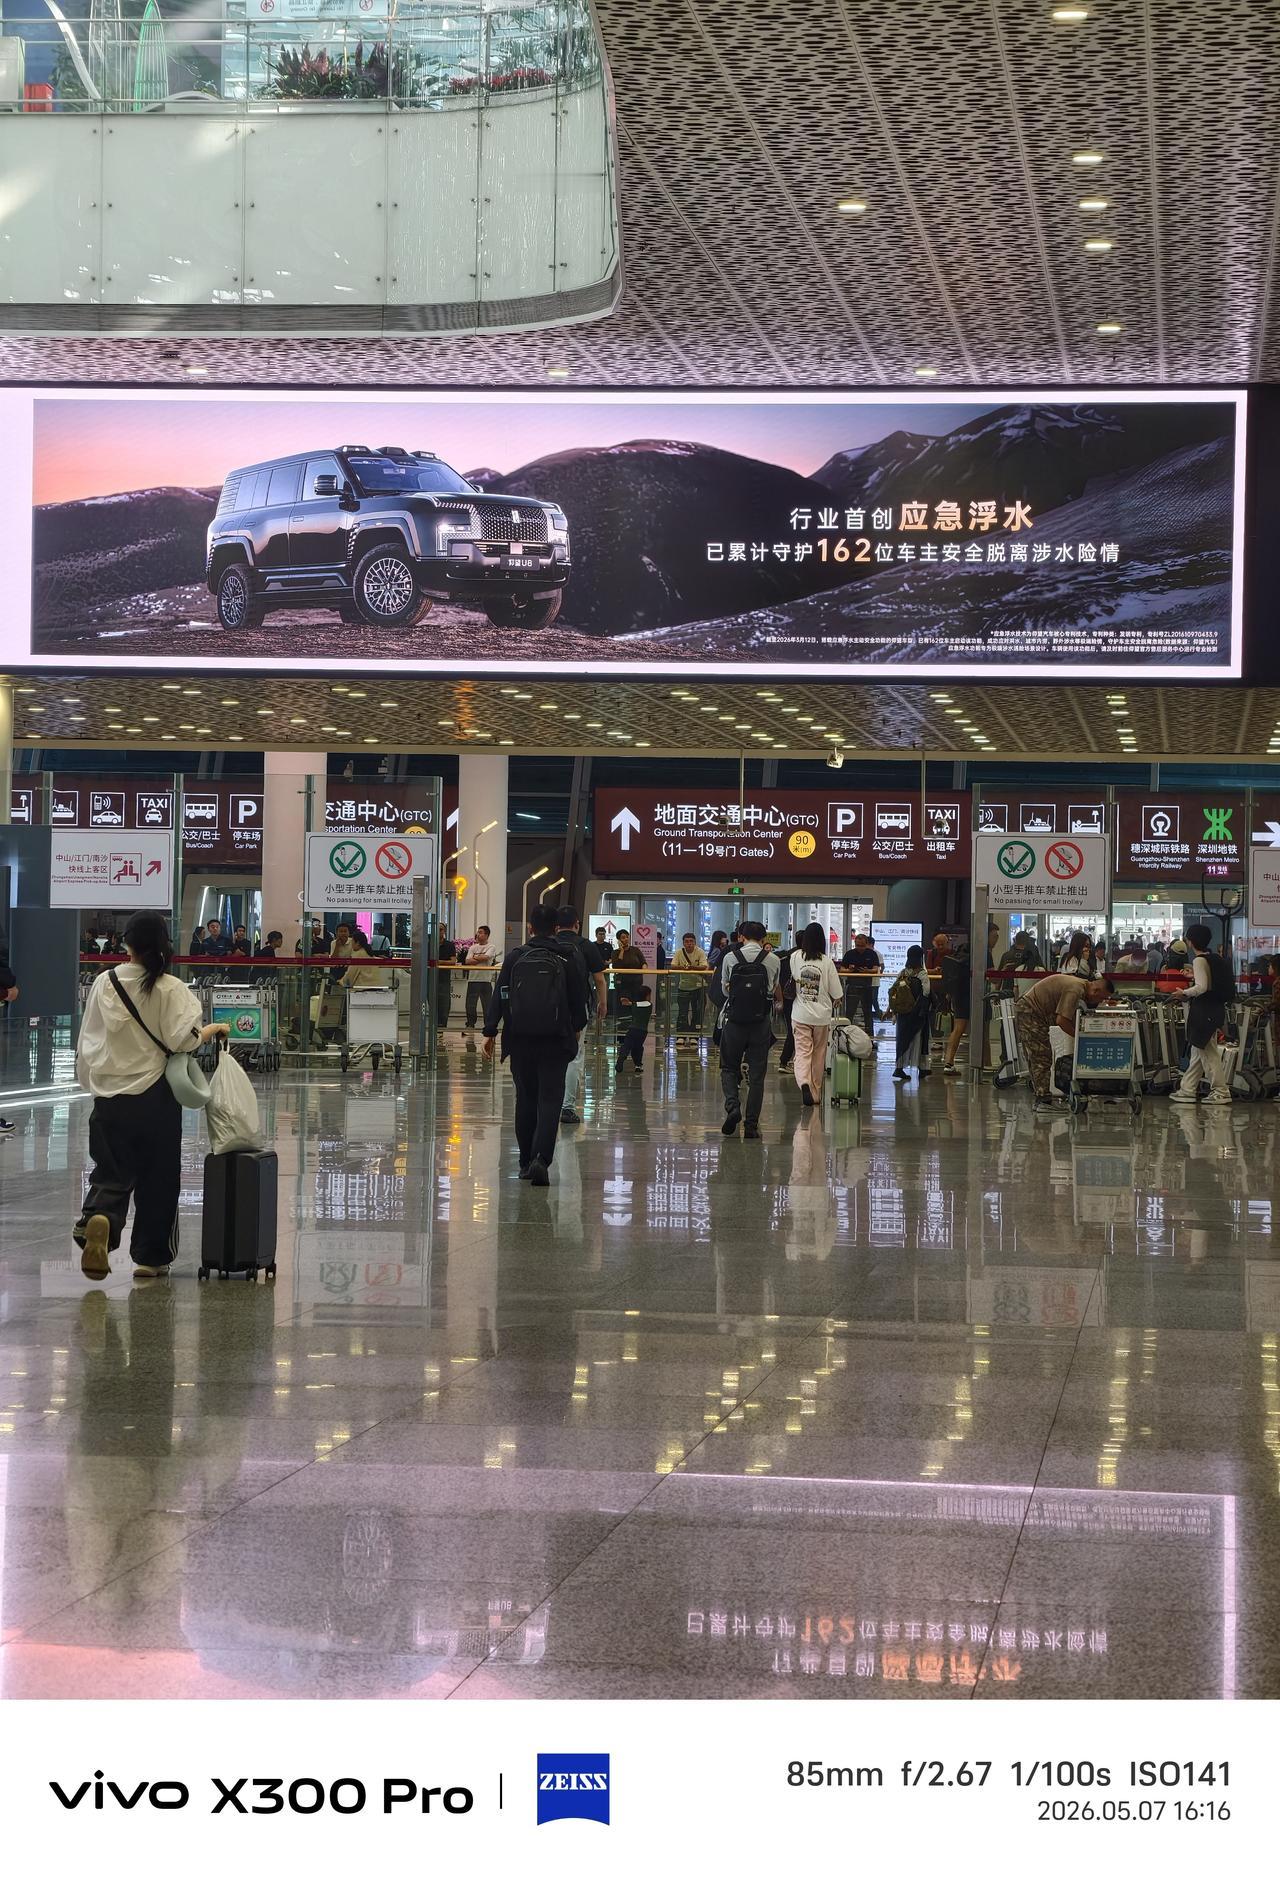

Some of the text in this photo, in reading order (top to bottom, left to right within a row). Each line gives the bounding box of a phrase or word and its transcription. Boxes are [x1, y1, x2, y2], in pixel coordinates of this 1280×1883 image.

[789, 500, 1034, 531] 行业首创应急浮水
[706, 538, 1119, 562] 已累计守护162位车主安全脱离涉水险情
[141, 798, 168, 809] TAXI
[238, 800, 257, 824] P
[927, 809, 956, 820] TAXI
[836, 808, 856, 833] P
[368, 825, 397, 833] Center
[653, 828, 687, 838] Ground
[753, 830, 784, 839] Center
[181, 830, 221, 841] 公交/巴士
[232, 831, 261, 841] 停车场
[795, 836, 809, 845] 90
[831, 840, 860, 851] 停车场
[872, 840, 914, 852] 公交/巴士
[926, 841, 956, 852] 出租车
[1130, 843, 1190, 854] 穗深城际铁路
[1197, 844, 1238, 855] 深圳地铁
[55, 854, 108, 863] 中山/江门/南沙
[69, 865, 108, 873] 快线上客区
[325, 884, 413, 895] 小型手推车禁止推出
[992, 884, 1088, 896] 小型手推车禁止推出
[337, 897, 362, 905] passing
